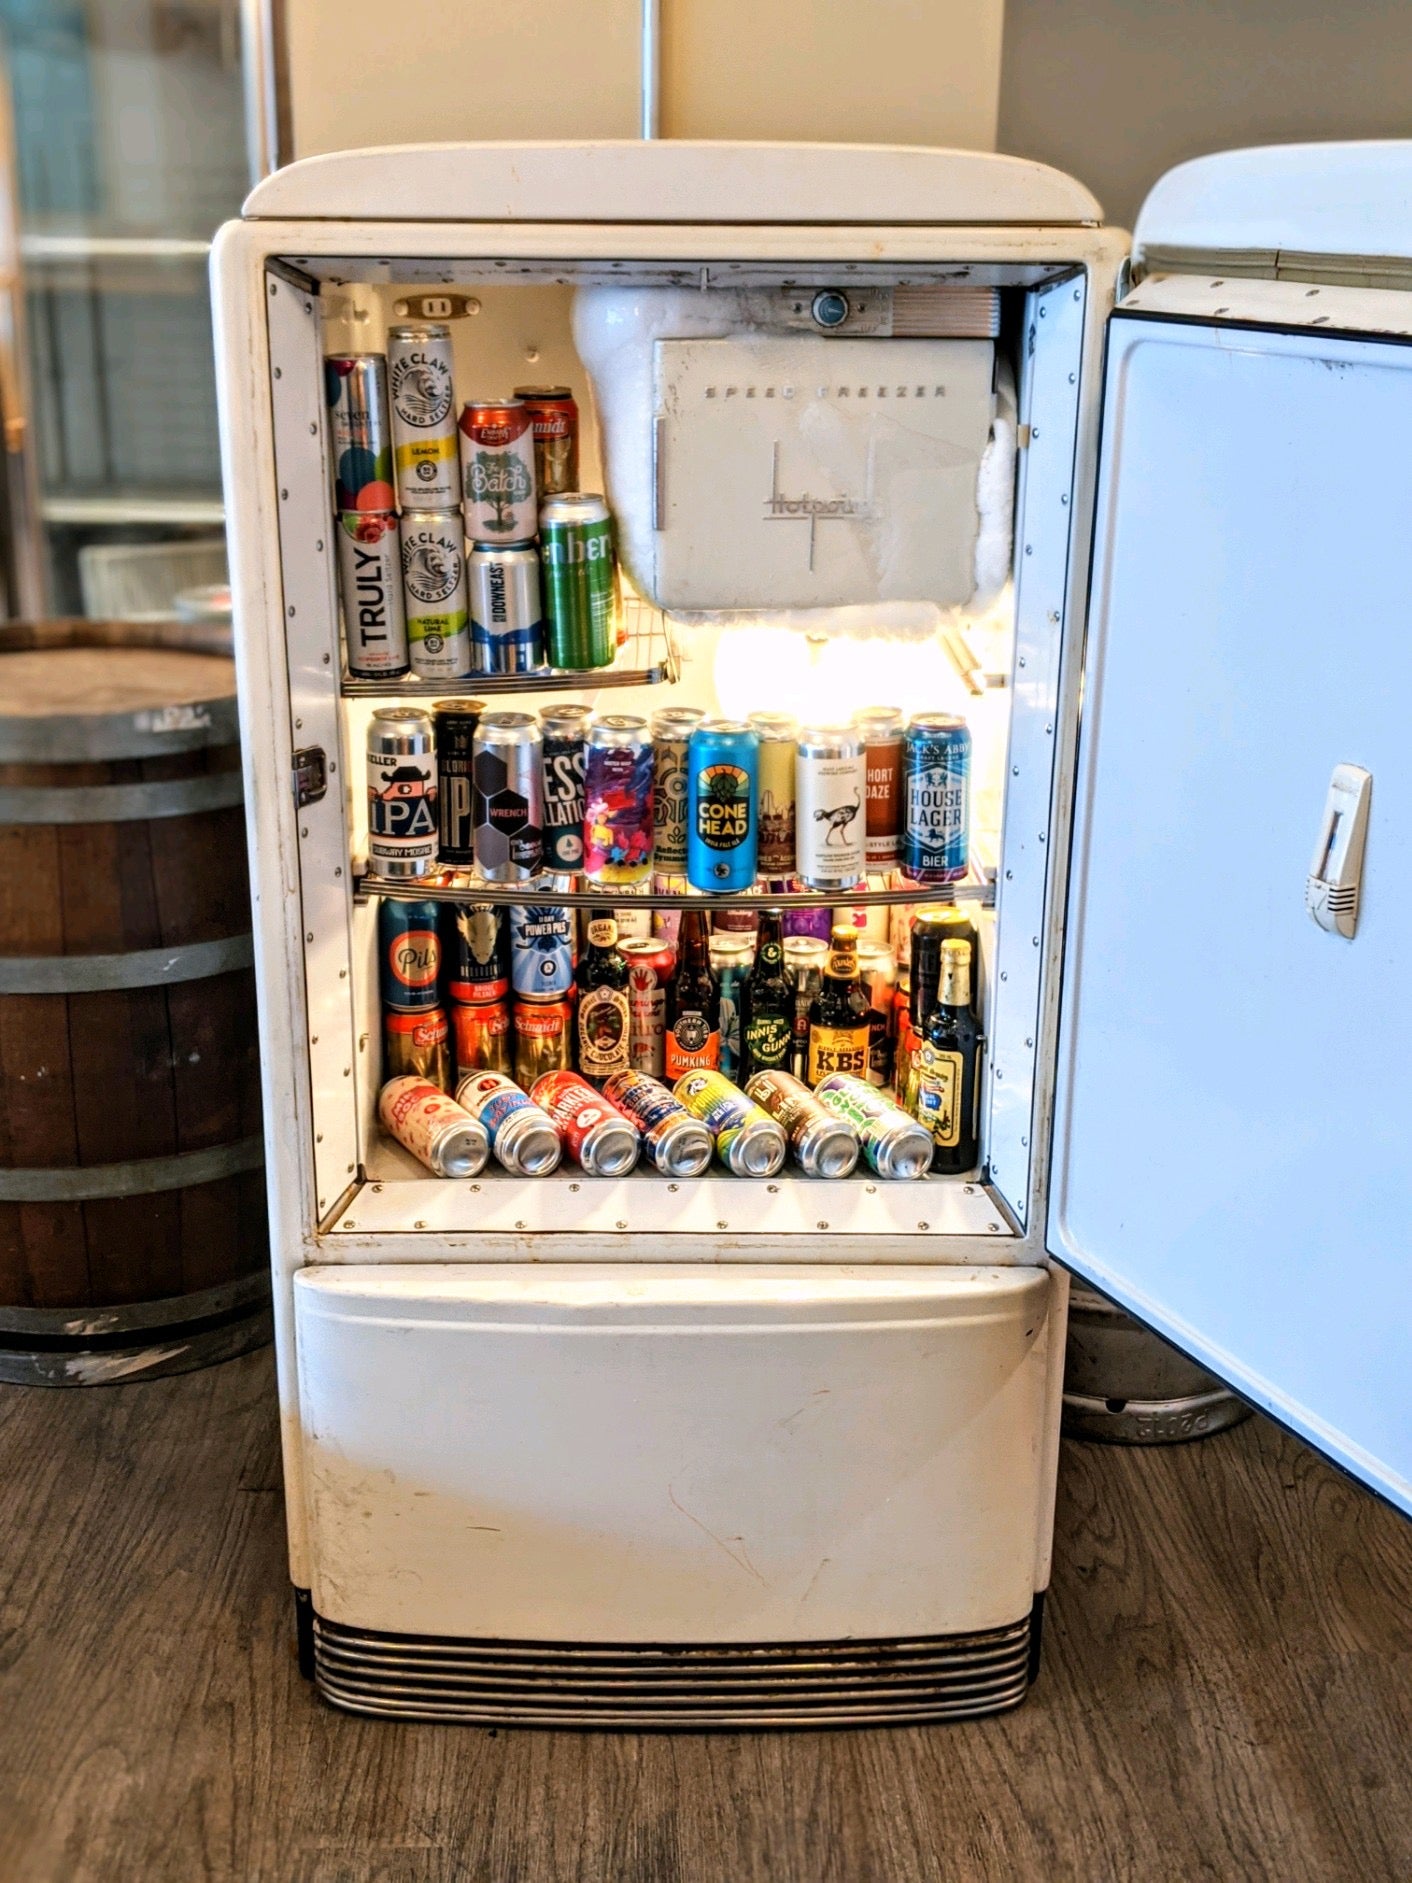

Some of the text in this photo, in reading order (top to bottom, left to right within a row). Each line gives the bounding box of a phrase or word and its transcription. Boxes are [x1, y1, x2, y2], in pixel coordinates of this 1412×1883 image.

[393, 353, 449, 400] WHITE CLAW
[411, 447, 440, 456] LEMON
[471, 463, 527, 493] Batch
[419, 532, 457, 554] CLAW
[353, 547, 388, 648] TRULY
[910, 789, 962, 808] HOUSE
[371, 798, 436, 836] IPA
[440, 775, 474, 848] IP
[490, 808, 528, 818] WRENCH
[699, 802, 747, 819] CONE
[910, 808, 962, 827] LAGER
[699, 819, 748, 836] HEAD
[922, 855, 949, 867] BIER
[525, 922, 552, 936] POWER
[398, 948, 437, 975] Pils
[767, 947, 777, 959] &
[515, 1015, 560, 1032] Schmidt
[747, 1024, 778, 1041] INNIS
[762, 1030, 792, 1053] GUNN
[767, 1033, 777, 1044] &
[671, 1054, 711, 1068] PUMKING
[817, 1049, 865, 1072] KBS
